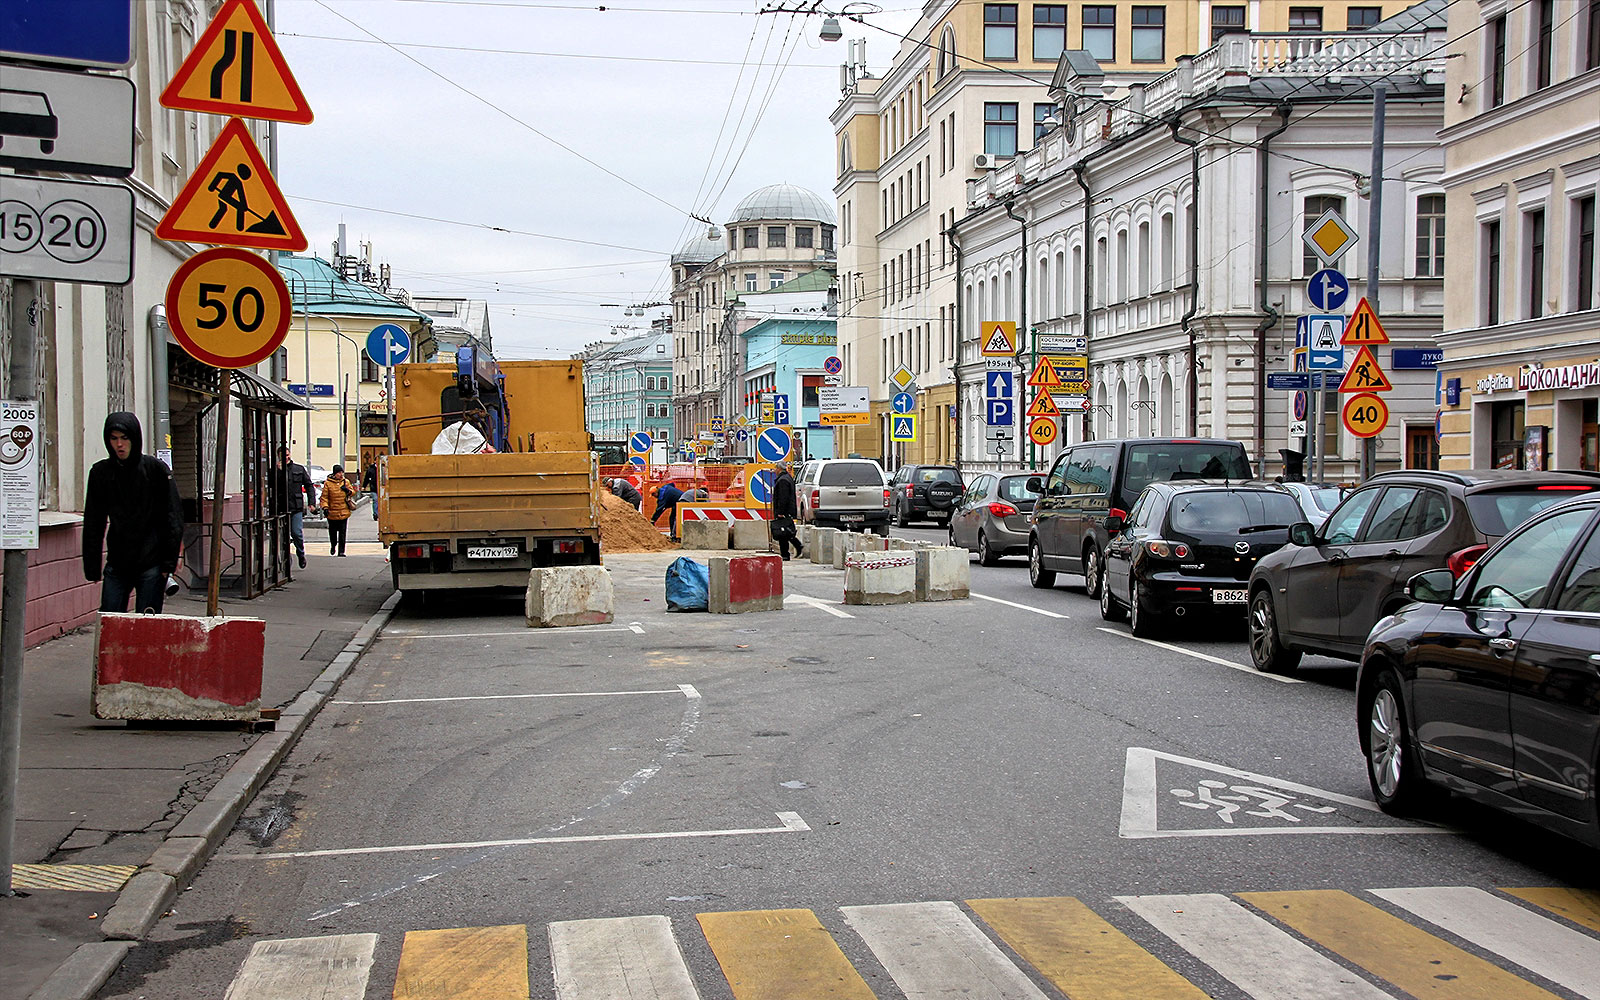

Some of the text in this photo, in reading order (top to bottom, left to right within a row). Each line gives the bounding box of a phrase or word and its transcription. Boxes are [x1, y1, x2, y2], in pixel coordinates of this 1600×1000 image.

[0, 211, 98, 249] 15 20
[196, 282, 265, 333] 50
[781, 330, 814, 344] simple
[1421, 353, 1443, 361] ЛУКО
[1519, 364, 1600, 391] ШОКОЛАДНИ
[3, 409, 35, 420] 2005
[778, 411, 787, 424] P
[992, 402, 1008, 423] P
[1351, 406, 1378, 424] 40
[1034, 425, 1051, 437] 40
